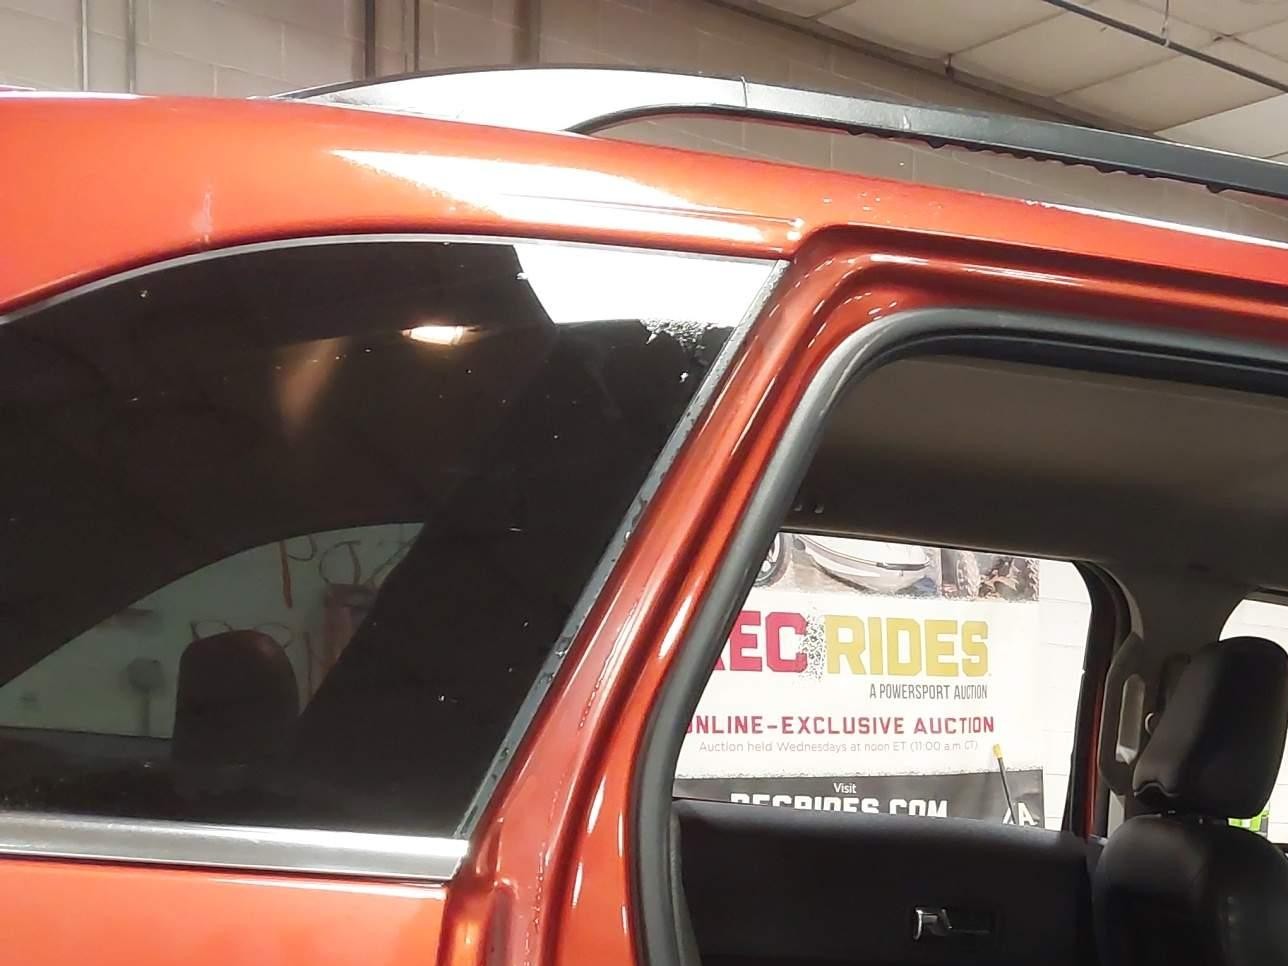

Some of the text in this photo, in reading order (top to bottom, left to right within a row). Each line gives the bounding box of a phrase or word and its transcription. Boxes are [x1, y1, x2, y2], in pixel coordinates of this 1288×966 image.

[713, 611, 990, 677] EC RIDES
[869, 683, 988, 700] A POWERSPORT AUCTION
[913, 716, 995, 735] AUCTION
[699, 741, 744, 752] Auction
[747, 741, 773, 752] held
[776, 741, 847, 754] Wednesdays
[850, 742, 861, 752] at
[864, 743, 890, 752] noon
[893, 741, 907, 751] ET
[833, 782, 857, 794] Visit
[730, 793, 948, 818] RIDESCOM
